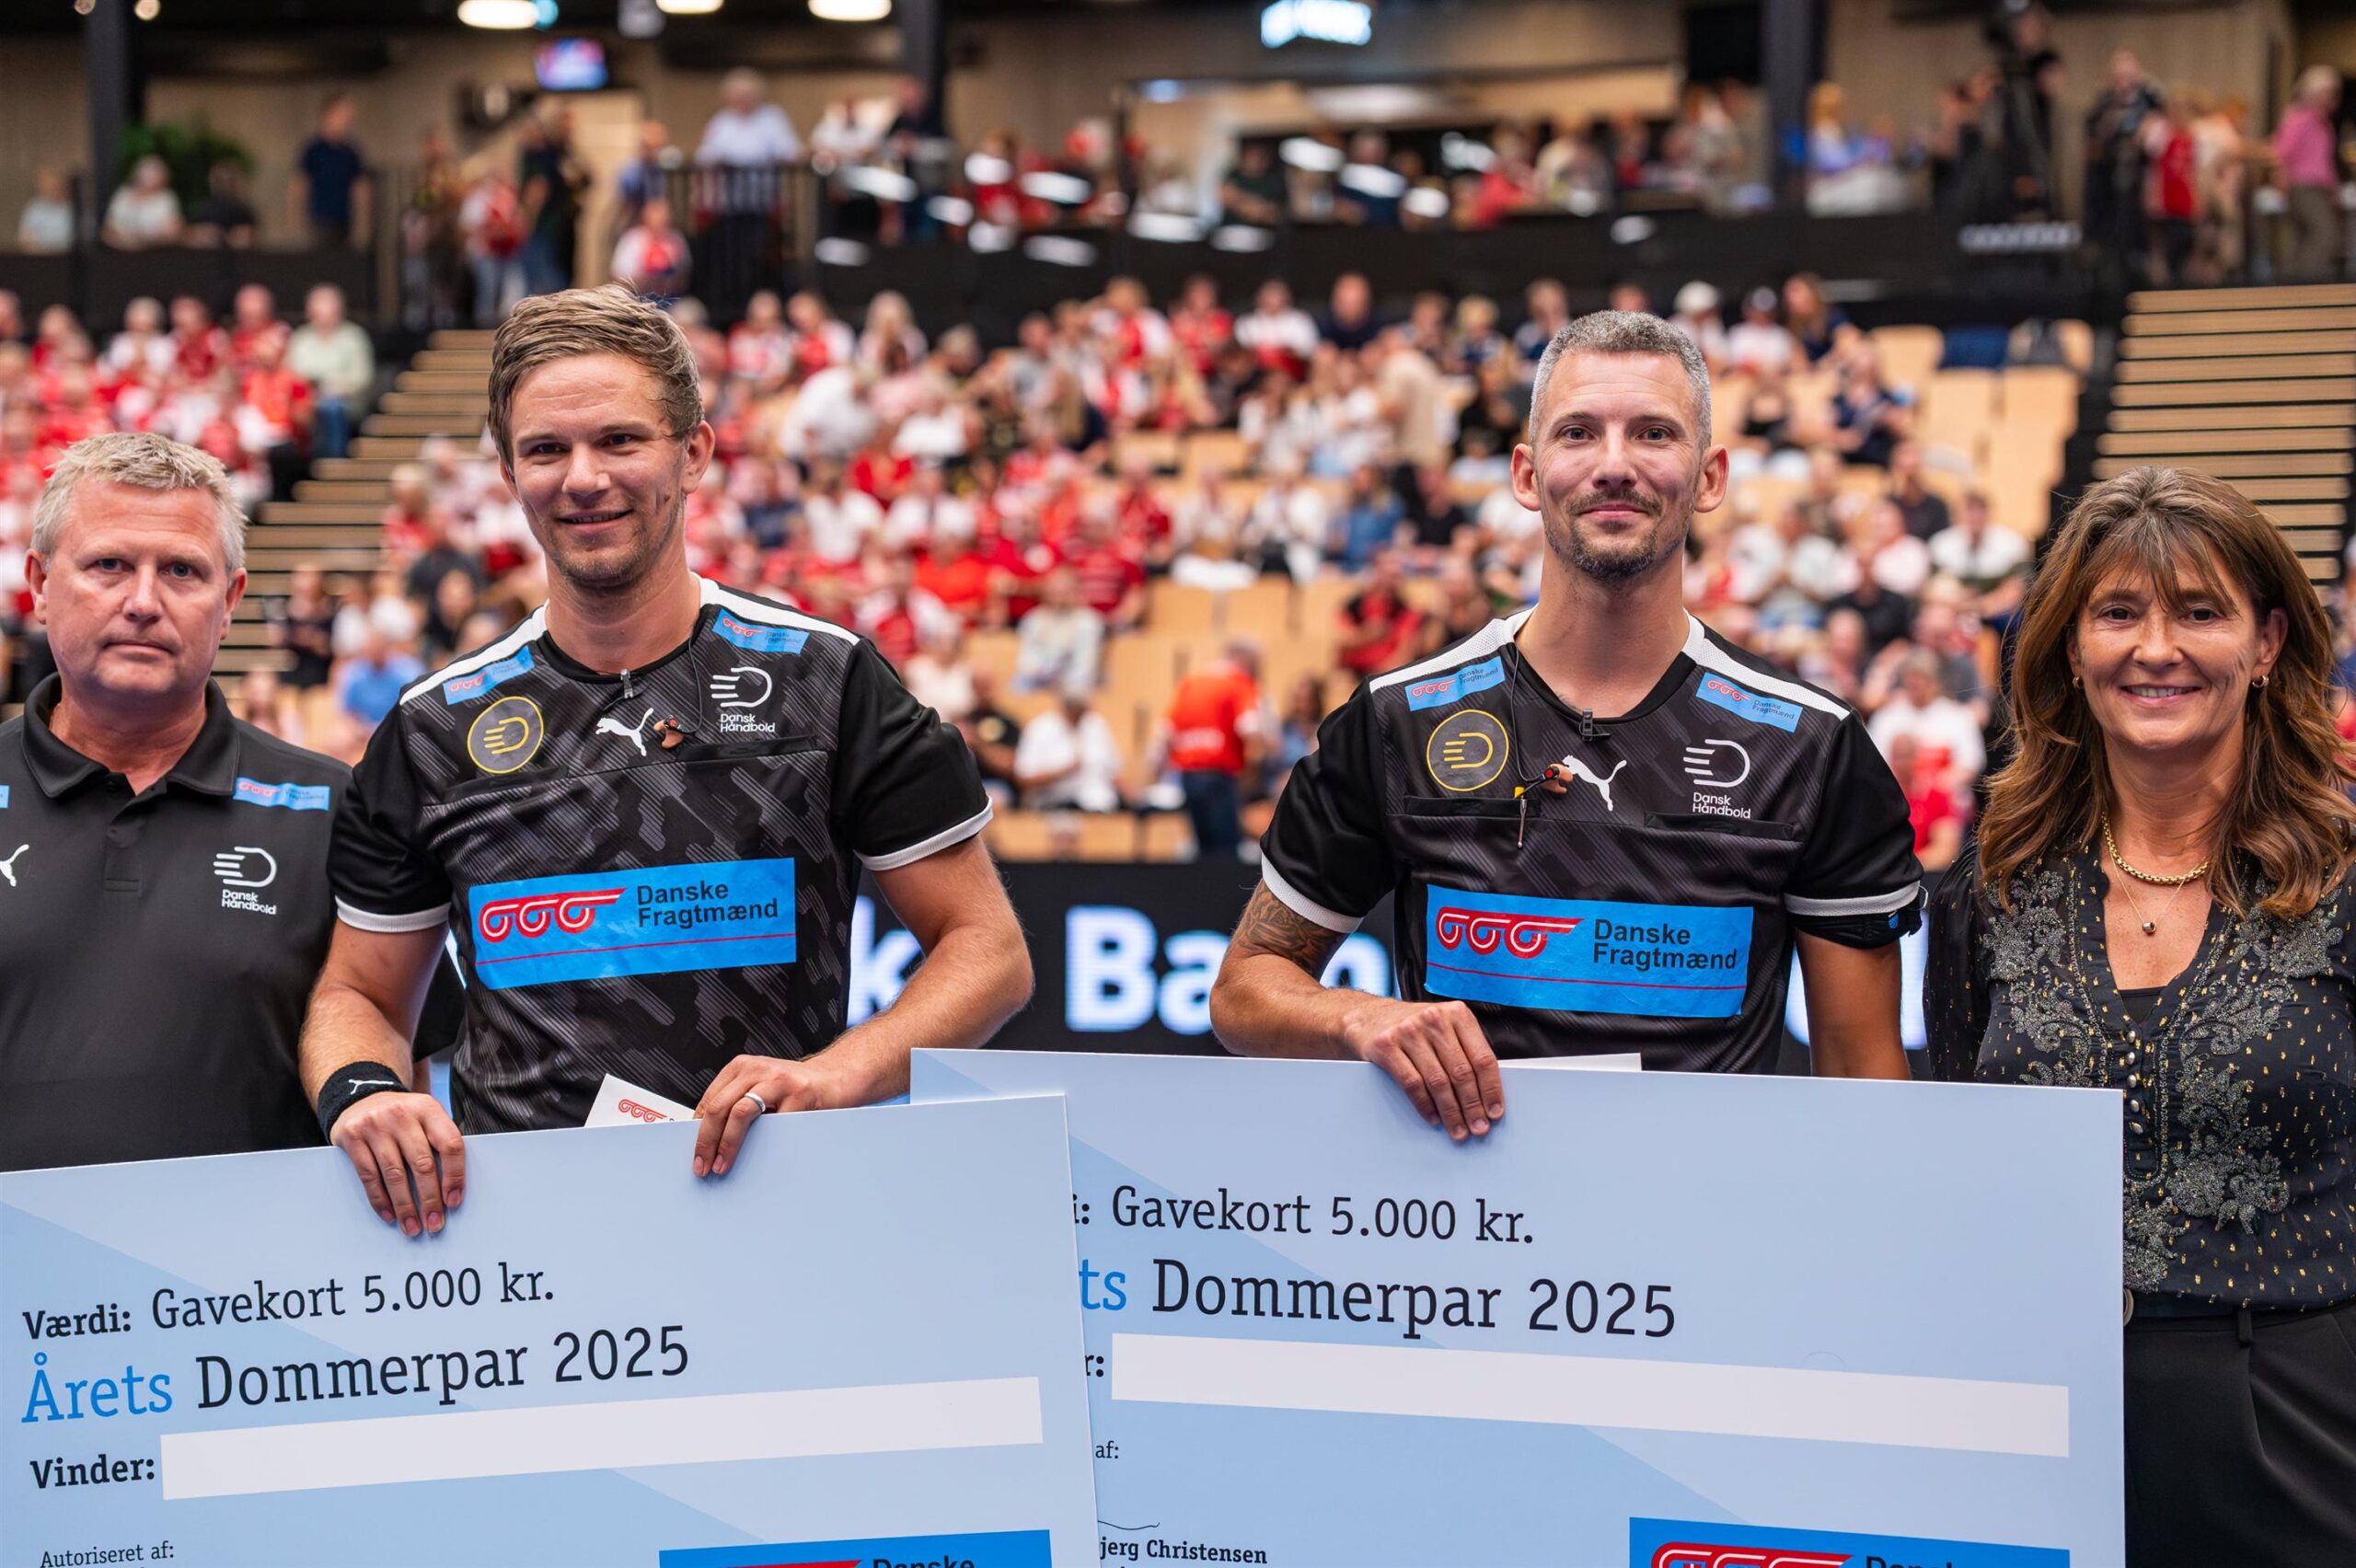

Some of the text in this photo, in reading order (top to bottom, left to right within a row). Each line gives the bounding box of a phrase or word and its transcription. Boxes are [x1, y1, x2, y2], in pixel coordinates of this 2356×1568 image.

[1752, 705, 1794, 719] Fragtmænd
[1754, 699, 1781, 709] Danske
[720, 713, 756, 723] Dansk
[720, 721, 775, 732] Håndbold
[1692, 802, 1750, 818] Håndbold
[1693, 792, 1730, 805] Dansk
[222, 889, 259, 902] Dansk
[637, 881, 729, 905] Danske
[222, 898, 276, 915] Håndbold
[638, 898, 779, 928] Fragtmænd
[1594, 918, 1691, 944] Danske
[1594, 943, 1737, 973] Fragtmænd
[1112, 1184, 1311, 1234] Gavekort
[1332, 1196, 1456, 1240] 5.000
[1475, 1198, 1533, 1244] kr.
[21, 1262, 554, 1340] Værdi: Gavekort 5.000 kr.
[1152, 1258, 1502, 1340] Dommerpar
[1529, 1278, 1675, 1338] 2025
[21, 1325, 688, 1424] Årets Dommerpar 2025
[1095, 1440, 1119, 1459] af:
[29, 1453, 155, 1489] Vinder:
[40, 1539, 174, 1568] Autoriseret af:
[1100, 1535, 1268, 1564] jerg Christensen
